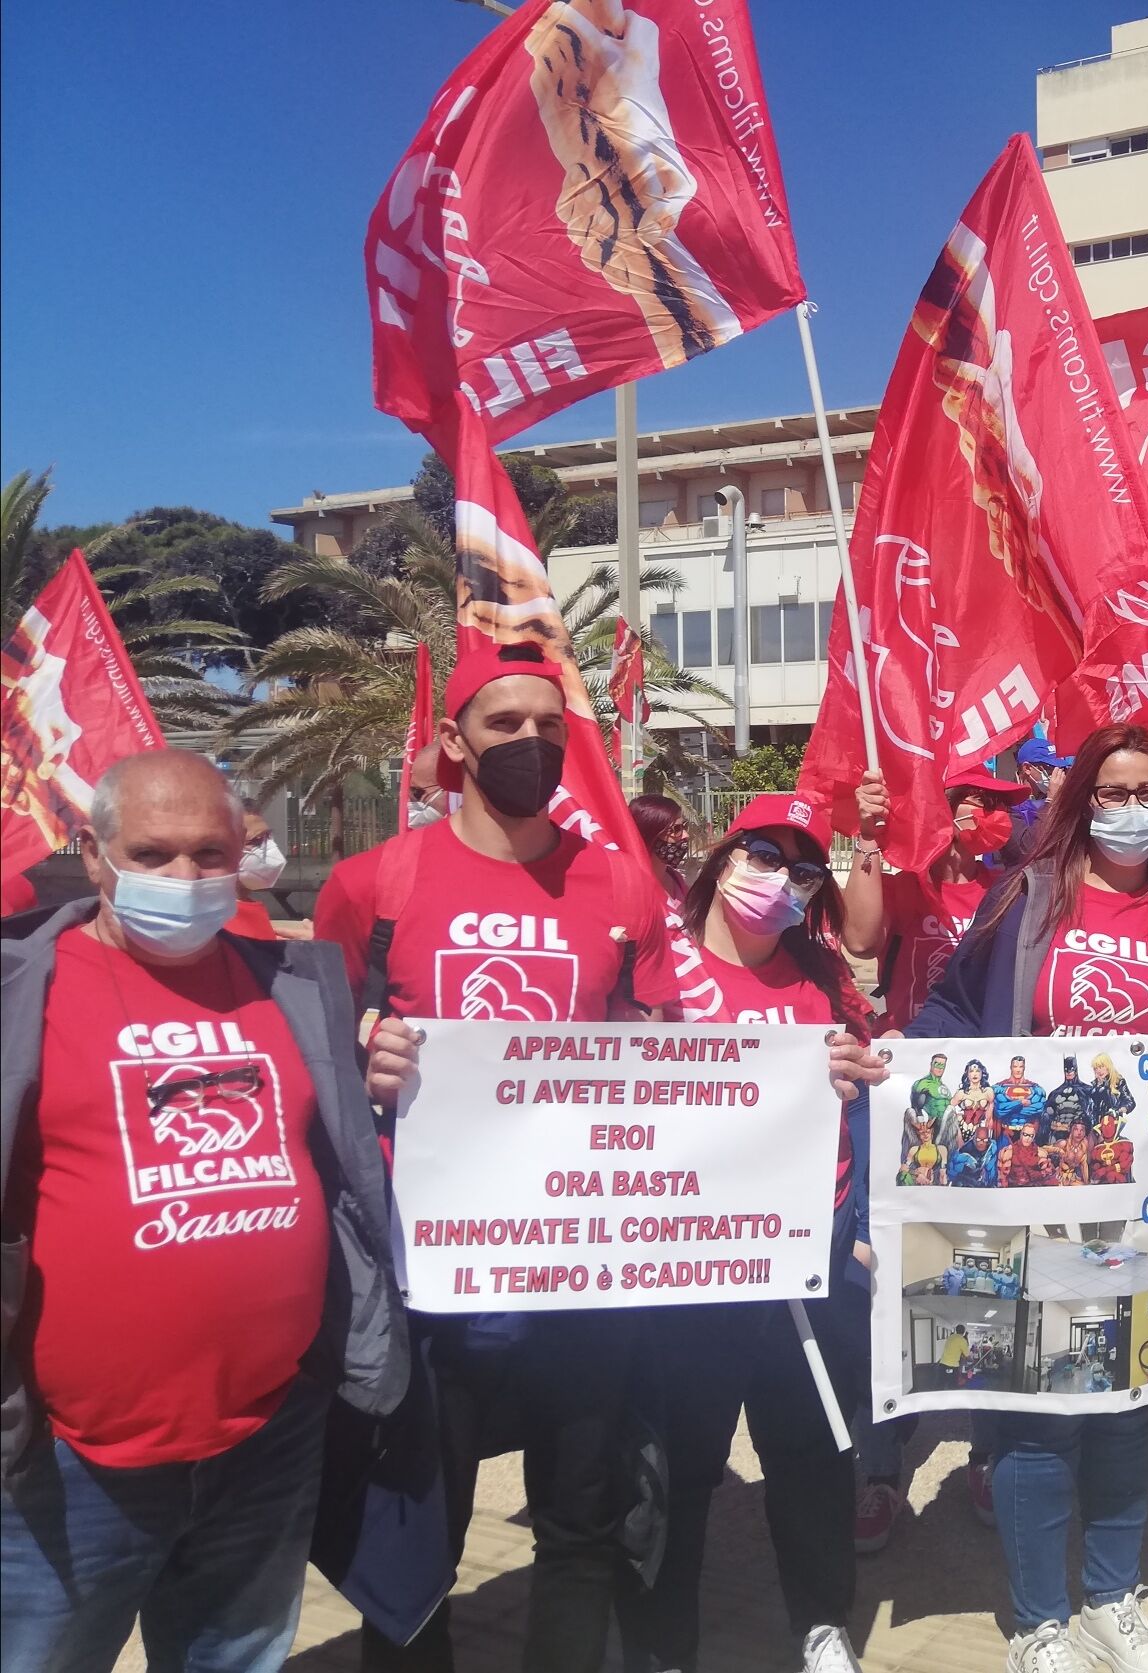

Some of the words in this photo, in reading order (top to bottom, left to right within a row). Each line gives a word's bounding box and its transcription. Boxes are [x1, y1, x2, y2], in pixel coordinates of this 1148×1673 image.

[449, 912, 568, 951] CGIL
[117, 1022, 256, 1057] CGIL
[503, 1036, 621, 1061] APPALTI
[496, 1079, 524, 1105] CI
[533, 1080, 624, 1105] AVETE
[634, 1081, 760, 1107] DEFINITO
[589, 1125, 655, 1150] EROI
[138, 1155, 288, 1193] FILCAMS
[545, 1172, 603, 1197] ORA
[612, 1171, 700, 1197] BASTA
[134, 1198, 300, 1249] Sassari
[414, 1218, 578, 1247] RINNOVATE
[588, 1217, 612, 1244] IL
[621, 1214, 781, 1242] CONTRATTO
[454, 1267, 480, 1294] IL
[490, 1265, 588, 1293] TEMPO
[597, 1264, 613, 1291] è
[620, 1258, 771, 1290] SCADUTO!!!
